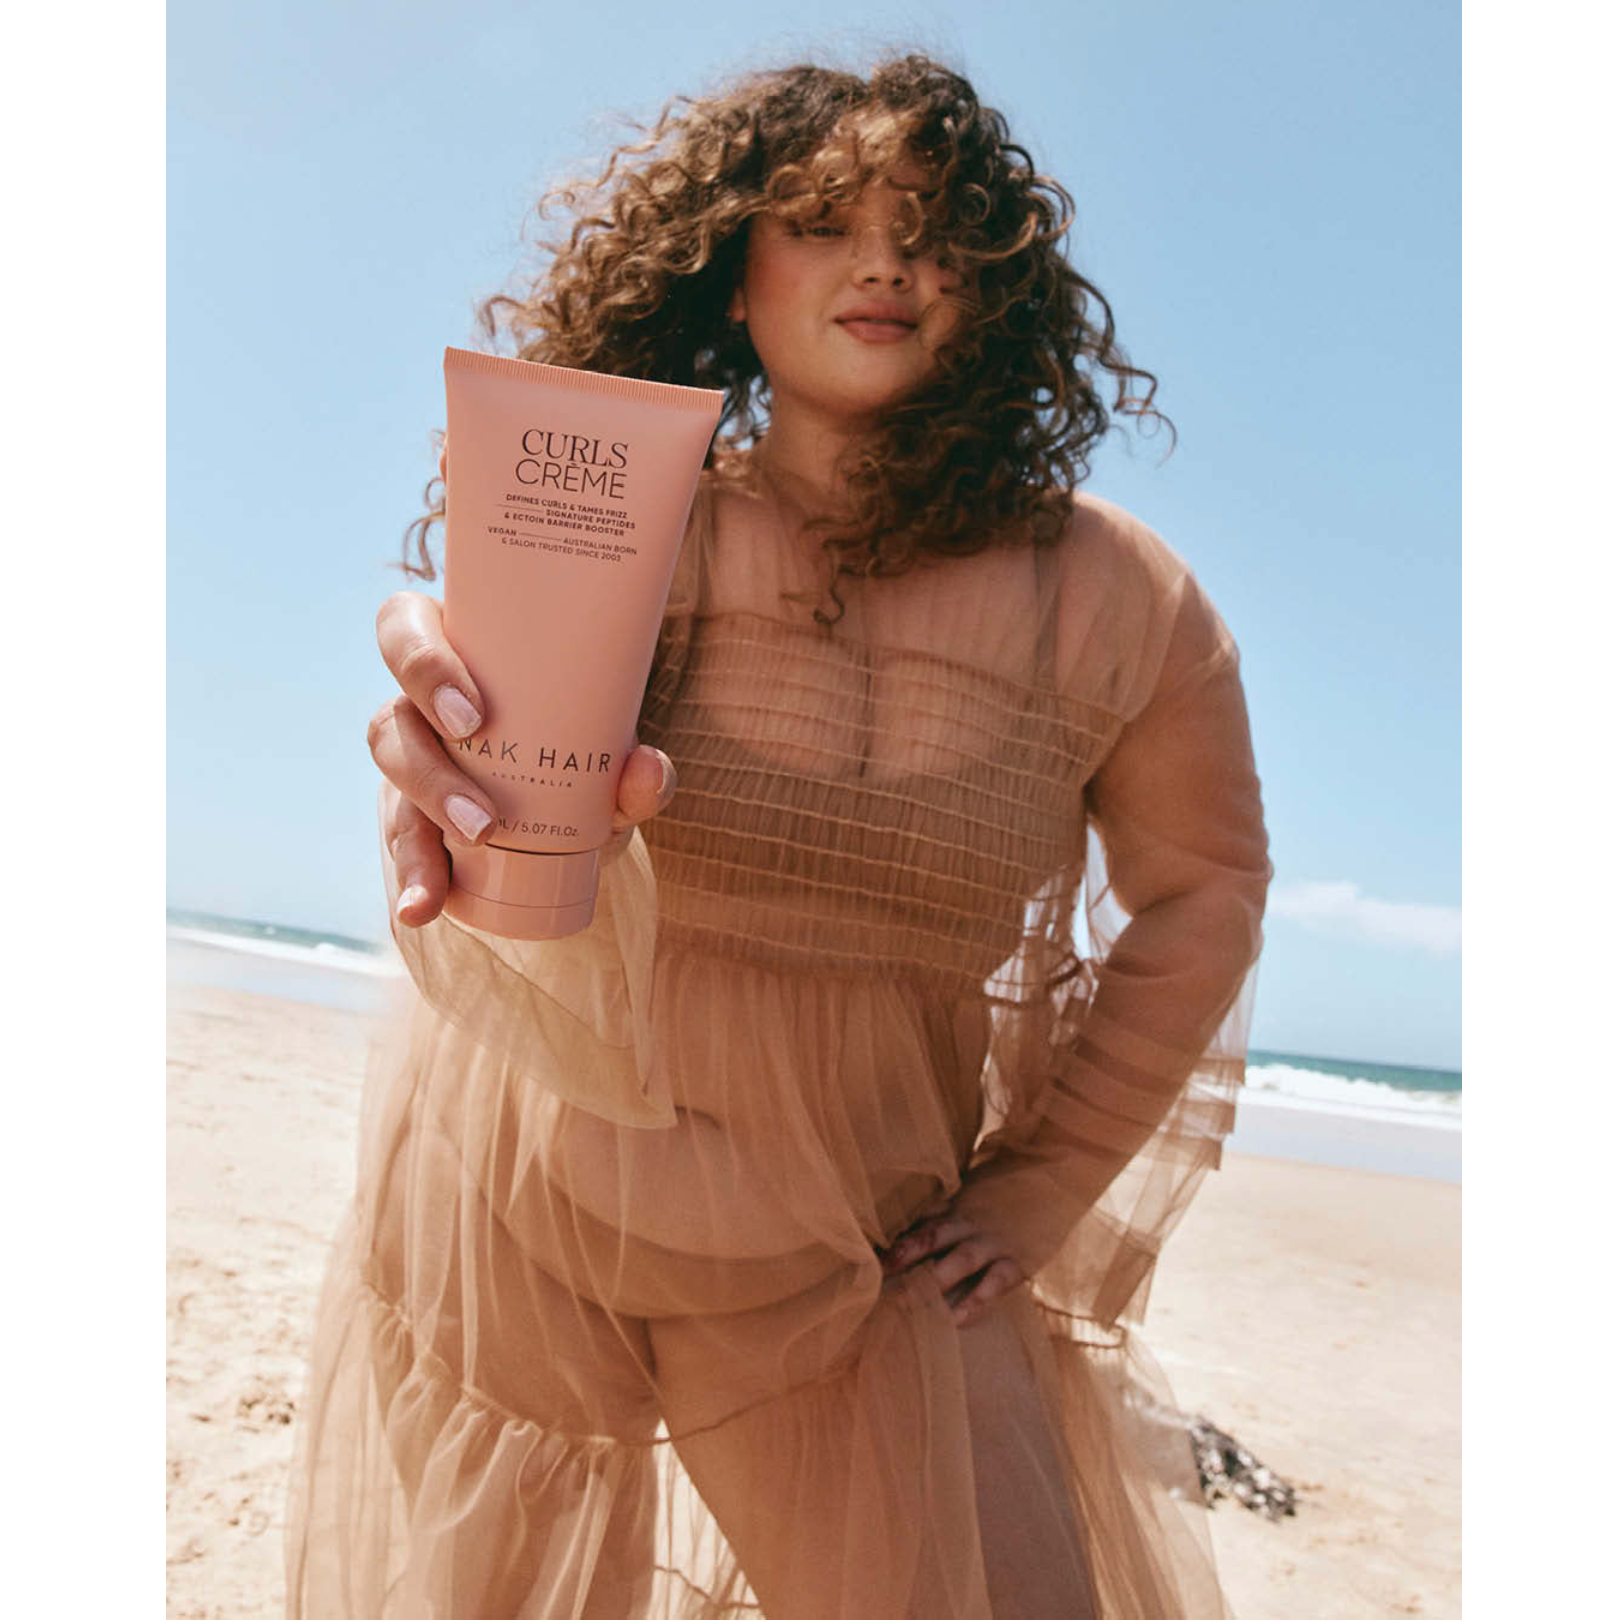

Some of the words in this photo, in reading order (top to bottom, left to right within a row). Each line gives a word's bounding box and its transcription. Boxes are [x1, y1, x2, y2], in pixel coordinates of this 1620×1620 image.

[522, 428, 628, 469] CURLS
[515, 458, 627, 499] CRÈME
[506, 493, 539, 506] DEFINES
[541, 499, 567, 510] CURLS
[577, 505, 604, 515] TAMES
[605, 509, 628, 519] FRIZZ
[512, 513, 545, 525] ECTOIN
[547, 519, 583, 531] BARRIER
[585, 524, 625, 537] BOOSTER
[546, 509, 593, 523] SIGNATURE
[596, 516, 636, 530] PEPTIDES
[488, 526, 517, 537] VEGAN
[563, 537, 612, 552] AUSTRALIAN
[614, 544, 638, 556] BORN
[509, 538, 536, 549] SALON
[538, 542, 574, 555] TRUSTED
[575, 548, 600, 559] SINCE
[601, 552, 622, 562] 2003
[459, 738, 518, 763] NAK
[539, 747, 611, 773] HAIR
[492, 772, 572, 788] AUSTRALIA
